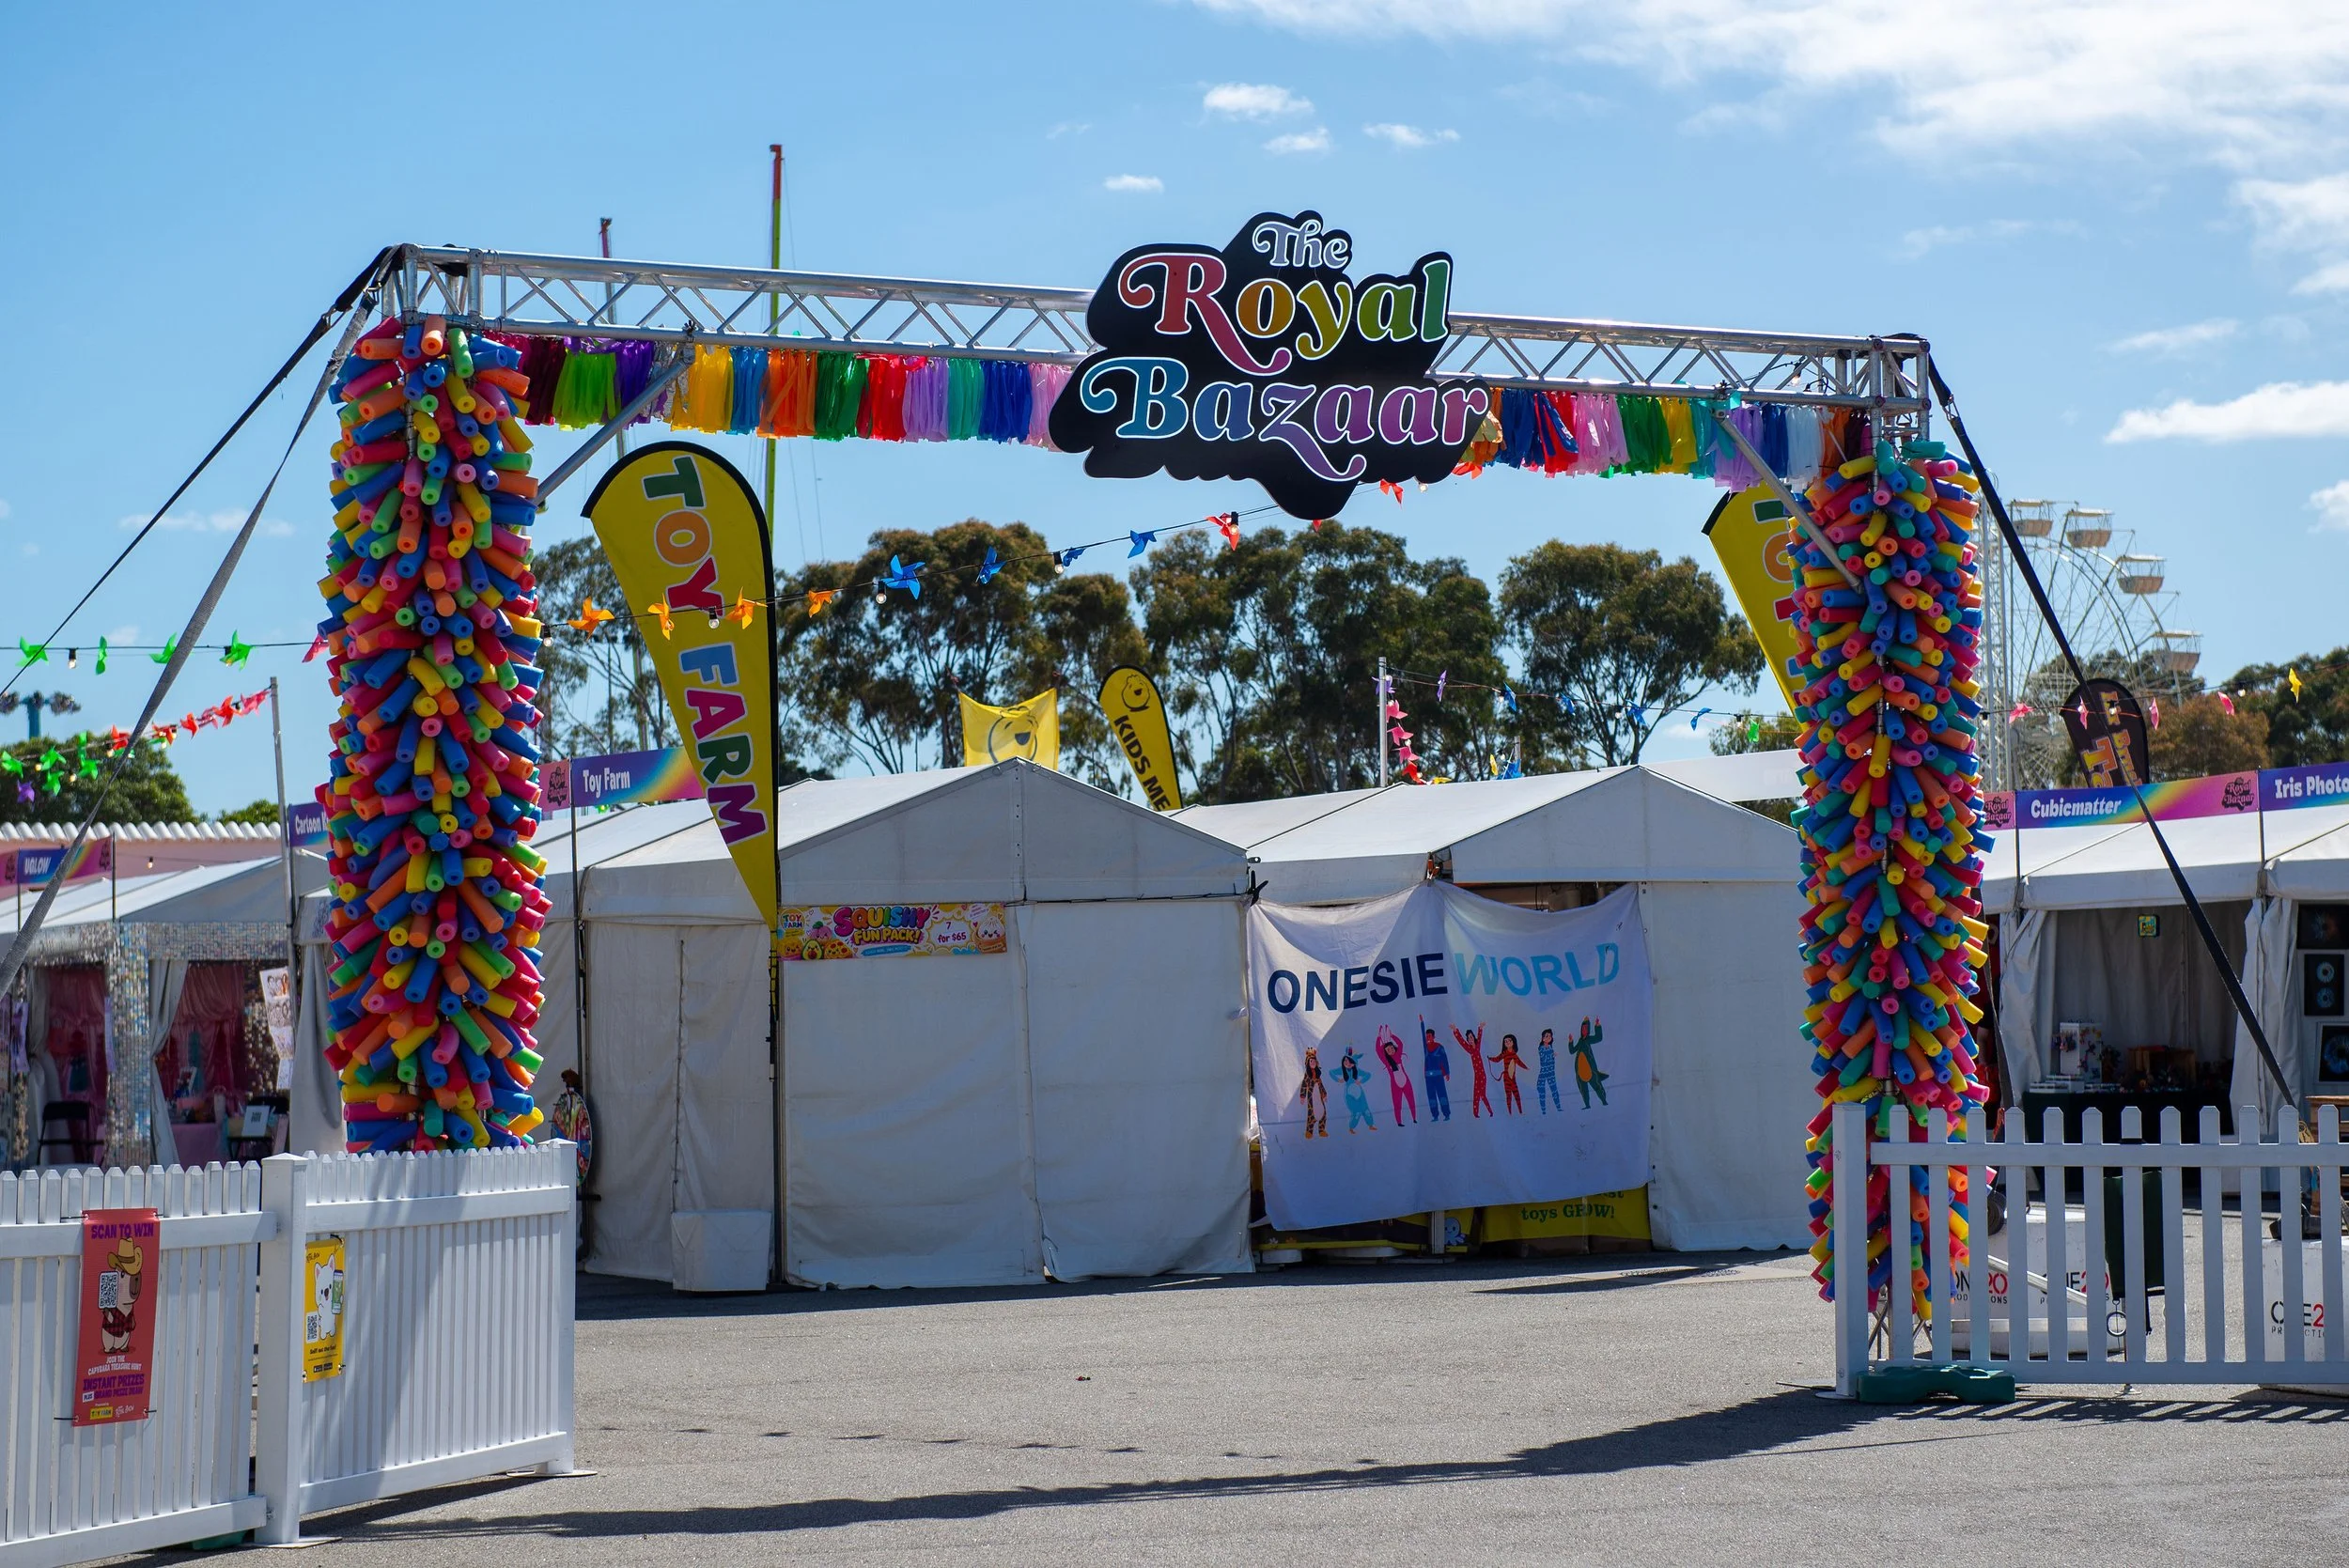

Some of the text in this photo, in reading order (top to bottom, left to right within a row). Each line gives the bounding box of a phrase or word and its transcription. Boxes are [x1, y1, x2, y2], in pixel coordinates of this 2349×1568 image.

[1252, 219, 1353, 269] The
[1118, 253, 1452, 376] Royal
[1080, 357, 1489, 481] Bazaar
[642, 454, 770, 846] TOY FARM
[1113, 714, 1152, 775] KIDS
[583, 767, 630, 799] Toy Farm
[2226, 780, 2251, 796] Royal
[2275, 776, 2303, 799] Iris
[1984, 800, 2008, 814] Royal
[2030, 797, 2122, 818] Cubicmatter
[2223, 794, 2255, 806] Bazaar
[295, 814, 321, 835] Cartoon
[1984, 812, 2012, 824] Bazaar
[24, 856, 52, 876] UGLOW
[832, 906, 931, 938] SQUISHY
[945, 922, 952, 930] 7
[853, 927, 922, 945] FUN PACK!
[938, 931, 967, 943] for $65
[1268, 941, 1620, 1014] ONESIE WORLD
[1520, 1206, 1558, 1223] toys
[91, 1222, 154, 1239] SCAN TO WIN
[87, 1364, 111, 1375] CAPYBARA
[111, 1362, 132, 1371] TREASURE
[83, 1374, 145, 1390] INSTANT PRIZES
[94, 1389, 112, 1399] GRAND
[112, 1388, 129, 1397] PRIZE
[129, 1387, 144, 1396] DRAW
